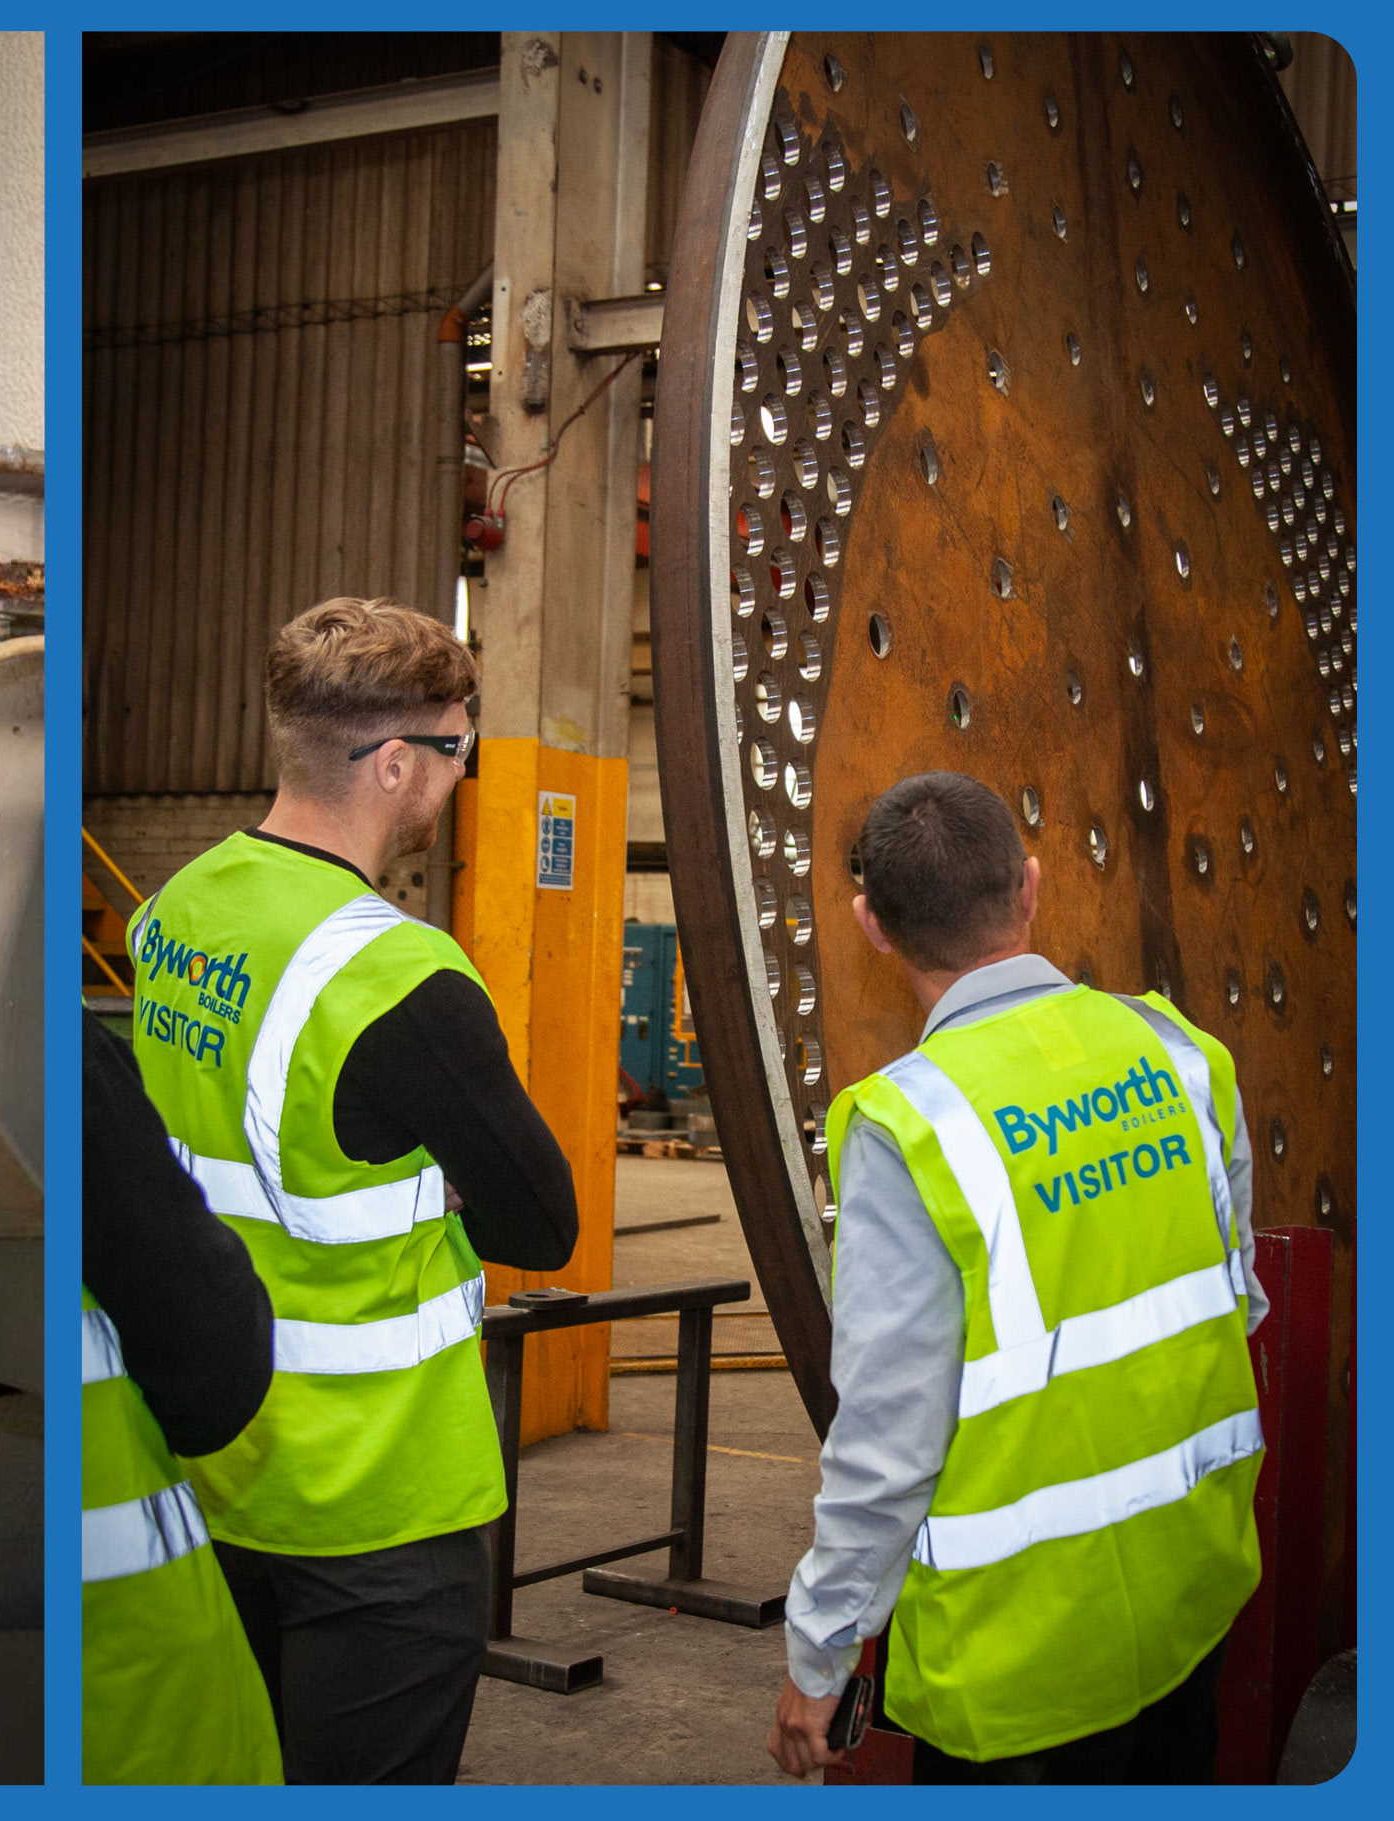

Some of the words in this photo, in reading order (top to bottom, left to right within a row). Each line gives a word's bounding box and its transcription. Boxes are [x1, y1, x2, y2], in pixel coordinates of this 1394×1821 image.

[141, 918, 251, 1009] Byworth
[140, 995, 225, 1068] VISITOR
[198, 992, 241, 1024] BOILERS
[993, 1055, 1179, 1156] Byworth
[1122, 1102, 1187, 1132] BOILERS
[1033, 1134, 1192, 1213] VISITOR
